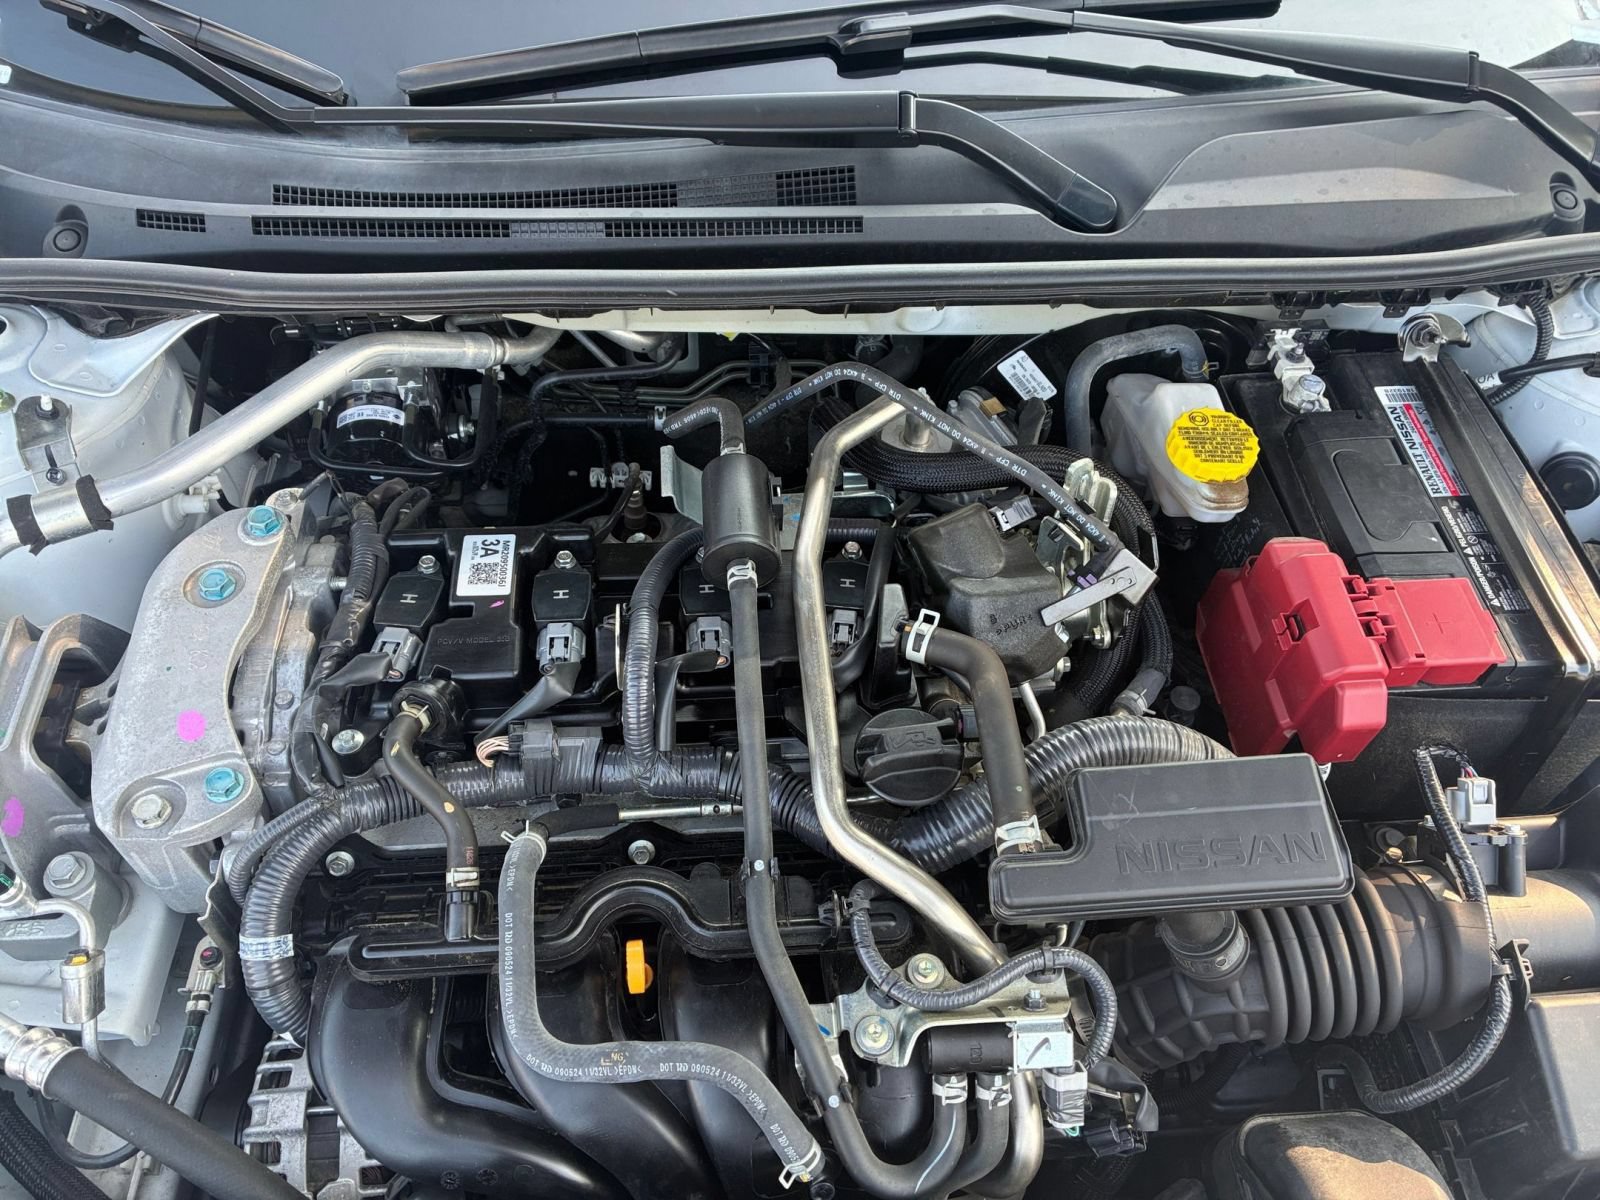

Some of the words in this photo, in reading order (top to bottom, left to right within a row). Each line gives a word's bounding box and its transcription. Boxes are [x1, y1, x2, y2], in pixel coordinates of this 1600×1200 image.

[874, 382, 887, 391] CFP
[888, 390, 902, 400] DTR
[920, 409, 936, 423] KINK
[937, 421, 950, 432] NOT
[1388, 406, 1419, 450] NISSAN
[951, 429, 961, 439] DO
[962, 436, 978, 449] 4X24
[996, 457, 1010, 467] CFP
[1012, 464, 1028, 476] DTR
[1412, 453, 1443, 494] RENAULT
[1048, 489, 1065, 504] KINK
[1064, 504, 1075, 515] NOT
[1076, 515, 1086, 523] DO
[1085, 523, 1100, 536] 4X24
[480, 539, 501, 558] 3A
[699, 585, 715, 593] H
[840, 578, 856, 588] H
[400, 594, 418, 603] H
[553, 590, 569, 599] H
[1115, 832, 1328, 875] NISSAN
[504, 947, 513, 975] 090524
[526, 1053, 539, 1067] DOT
[554, 1068, 582, 1076] 090524
[660, 1063, 673, 1072] DOT
[691, 1063, 720, 1076] 090524
[770, 1123, 783, 1136] DOT
